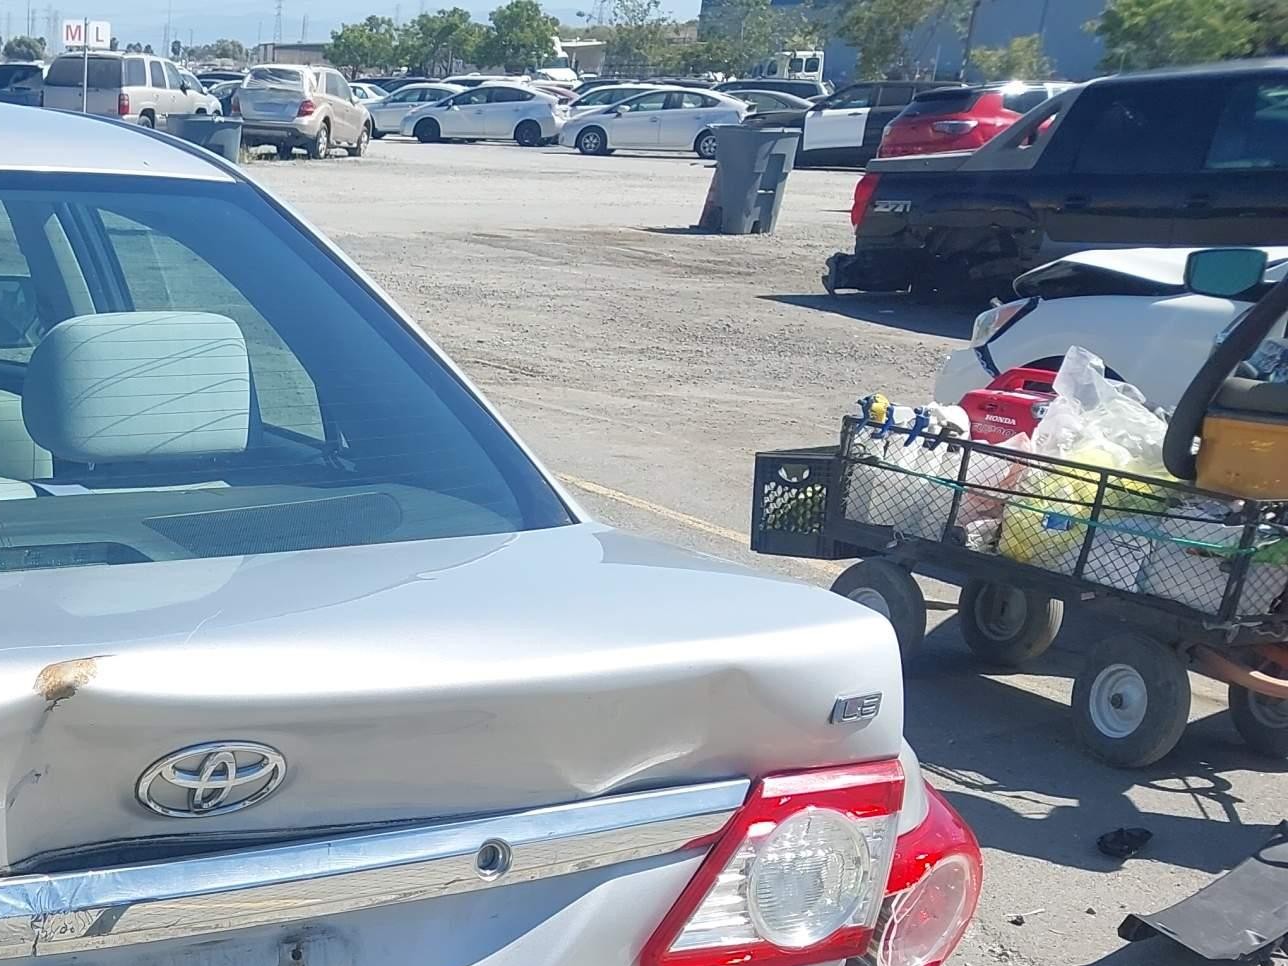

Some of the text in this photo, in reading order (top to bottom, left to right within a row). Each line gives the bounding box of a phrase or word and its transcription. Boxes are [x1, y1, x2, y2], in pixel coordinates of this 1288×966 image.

[65, 24, 82, 41] M
[95, 26, 105, 42] L
[873, 200, 912, 212] Z71
[985, 414, 1016, 425] HONDA
[831, 693, 882, 724] LE
